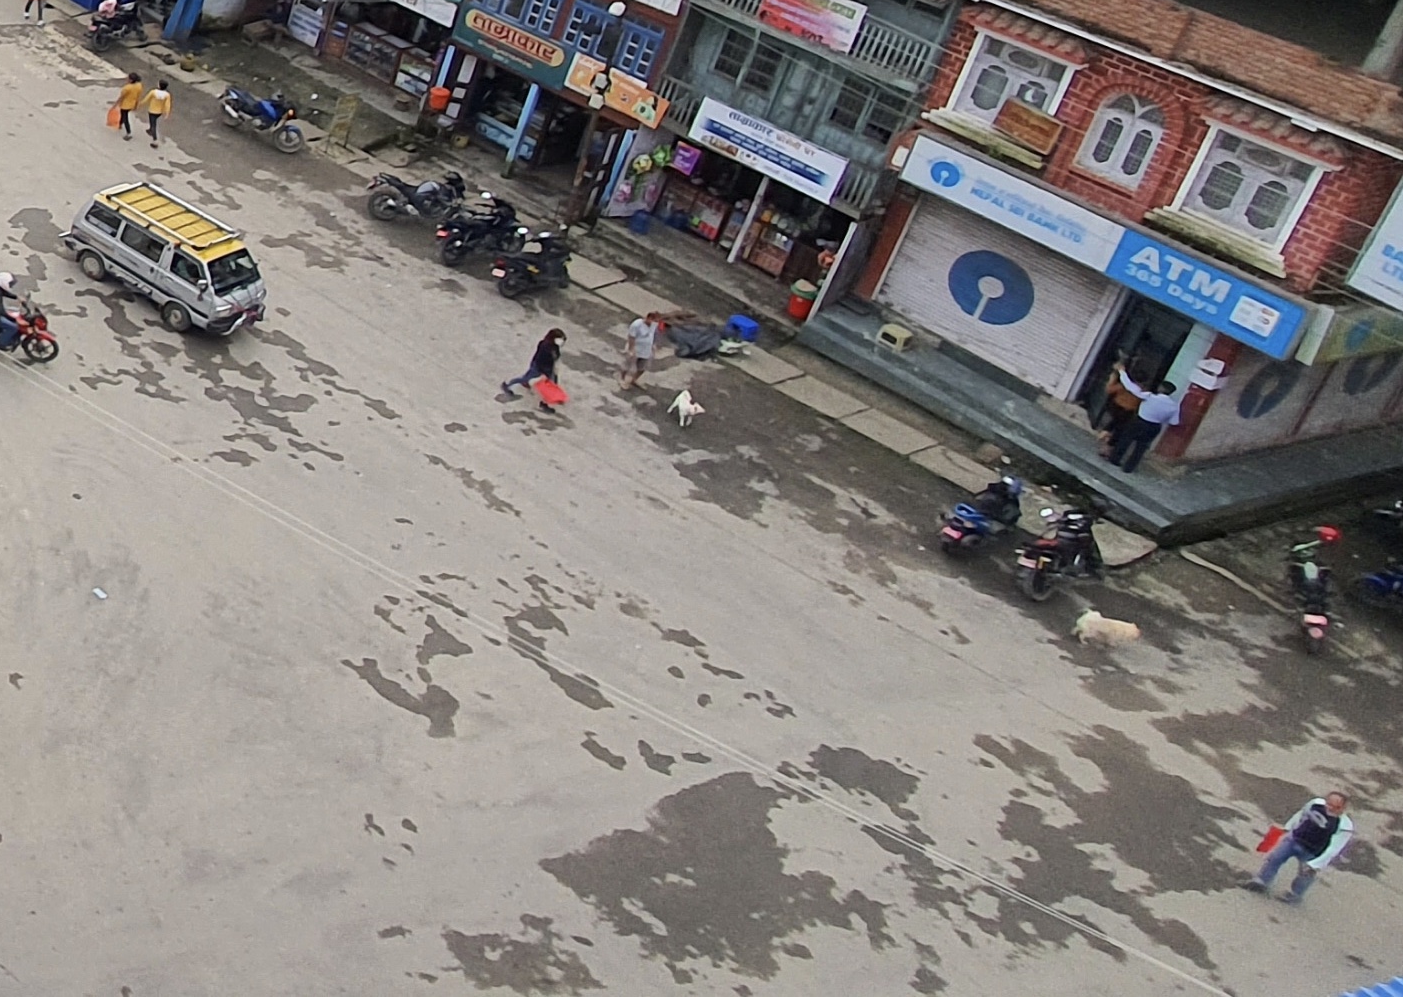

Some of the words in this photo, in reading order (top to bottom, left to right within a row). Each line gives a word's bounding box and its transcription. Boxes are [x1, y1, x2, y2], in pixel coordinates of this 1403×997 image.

[969, 186, 1006, 209] NEPAL
[1026, 211, 1059, 233] BANK
[1124, 263, 1163, 288] 365
[1166, 283, 1218, 315] Days
[1129, 246, 1233, 303] ATM
